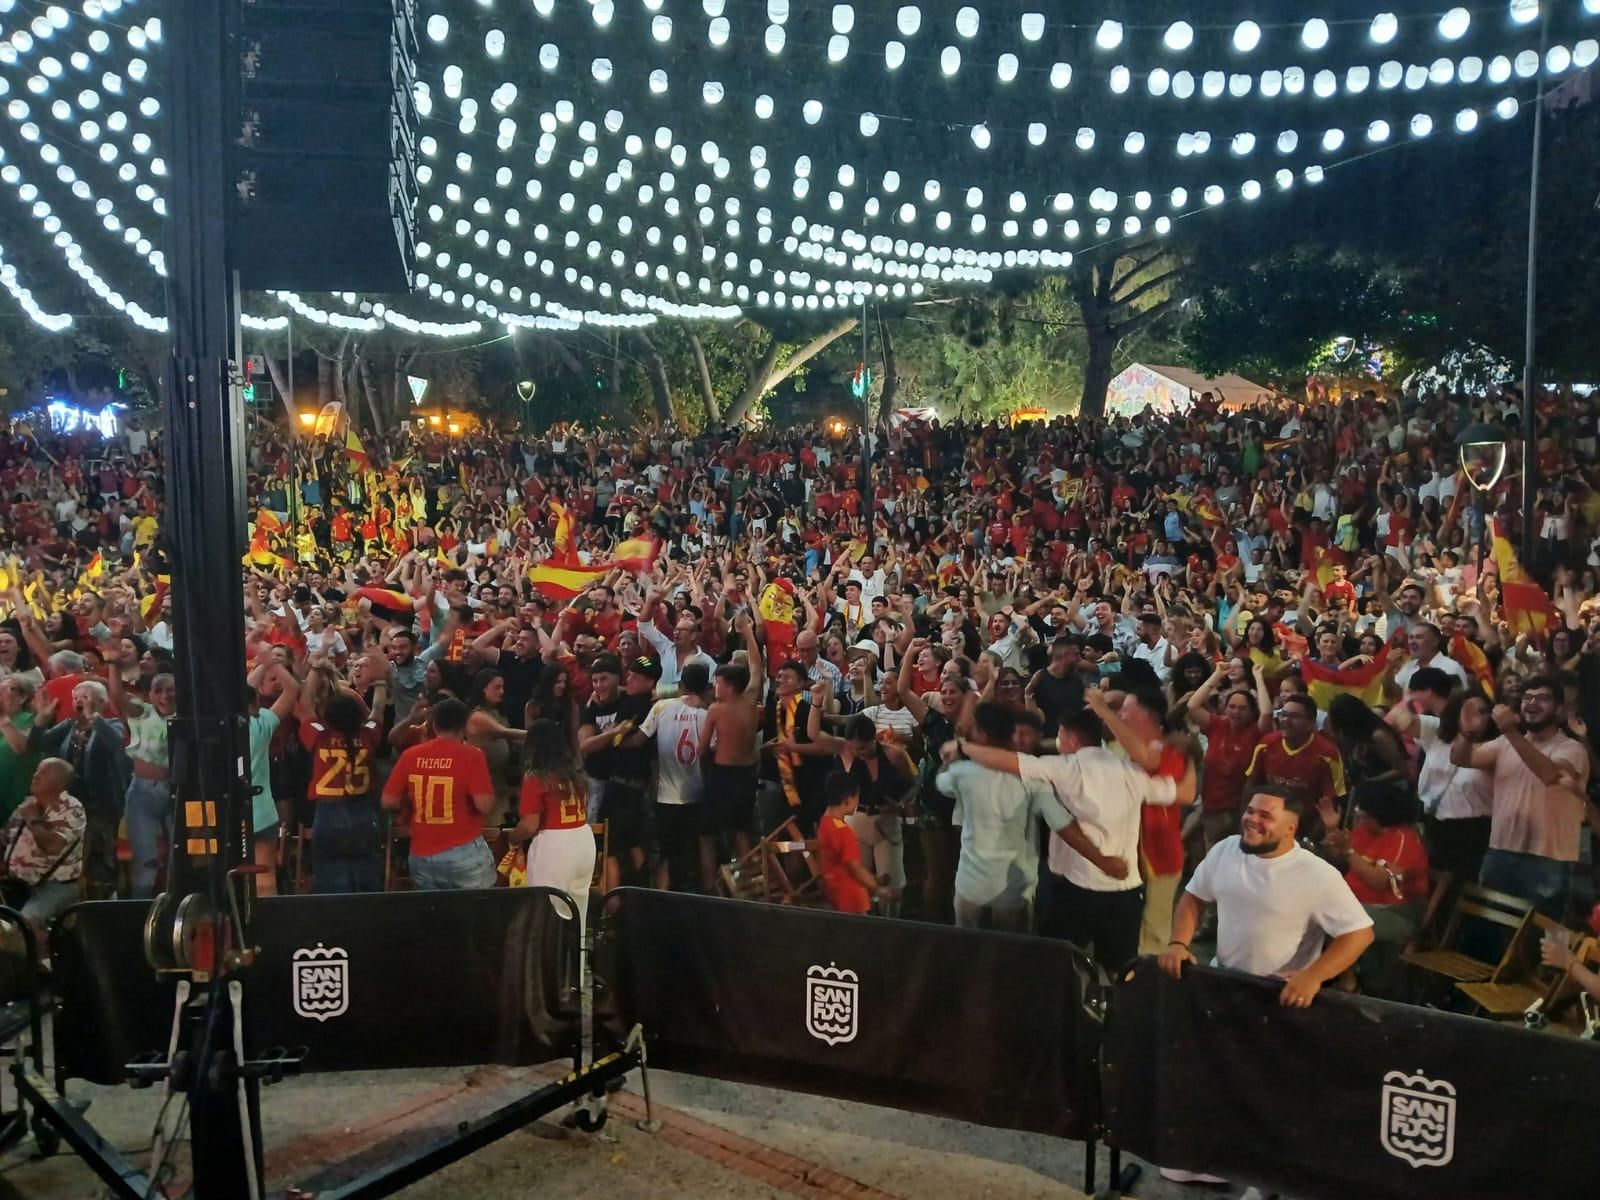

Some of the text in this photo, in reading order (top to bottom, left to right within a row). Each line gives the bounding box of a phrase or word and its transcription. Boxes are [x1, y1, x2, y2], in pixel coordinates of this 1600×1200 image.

[676, 728, 698, 765] 6
[315, 748, 370, 796] 26
[416, 757, 453, 769] THIAGO
[408, 774, 454, 824] 10
[301, 967, 341, 983] SAN
[814, 986, 851, 1006] SAN
[1392, 1096, 1445, 1122] SAN
